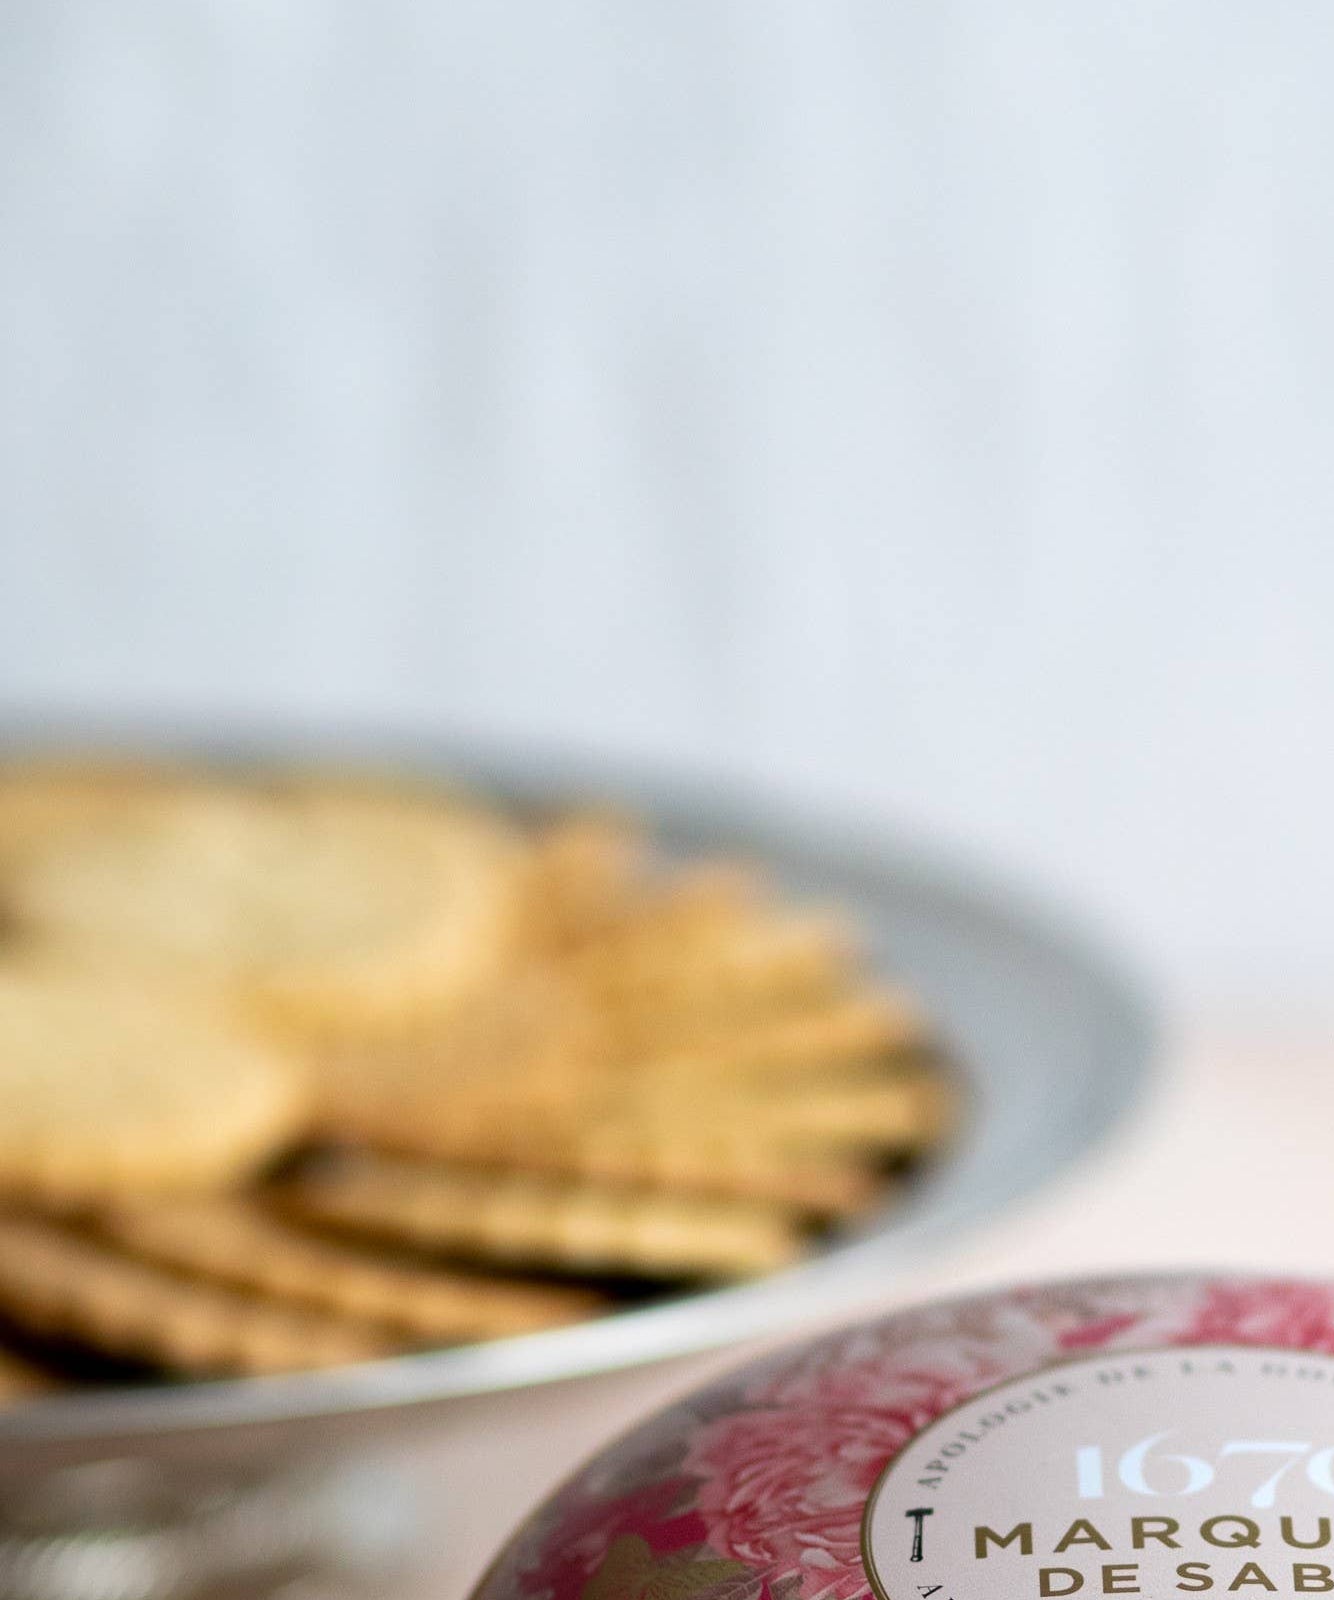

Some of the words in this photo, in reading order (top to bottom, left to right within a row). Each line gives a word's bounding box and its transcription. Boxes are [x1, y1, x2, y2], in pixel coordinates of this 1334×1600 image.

[917, 1384, 1072, 1490] APOLOGIE
[1097, 1363, 1149, 1386] DE
[1179, 1358, 1235, 1376] LA
[1037, 1564, 1140, 1598] DE
